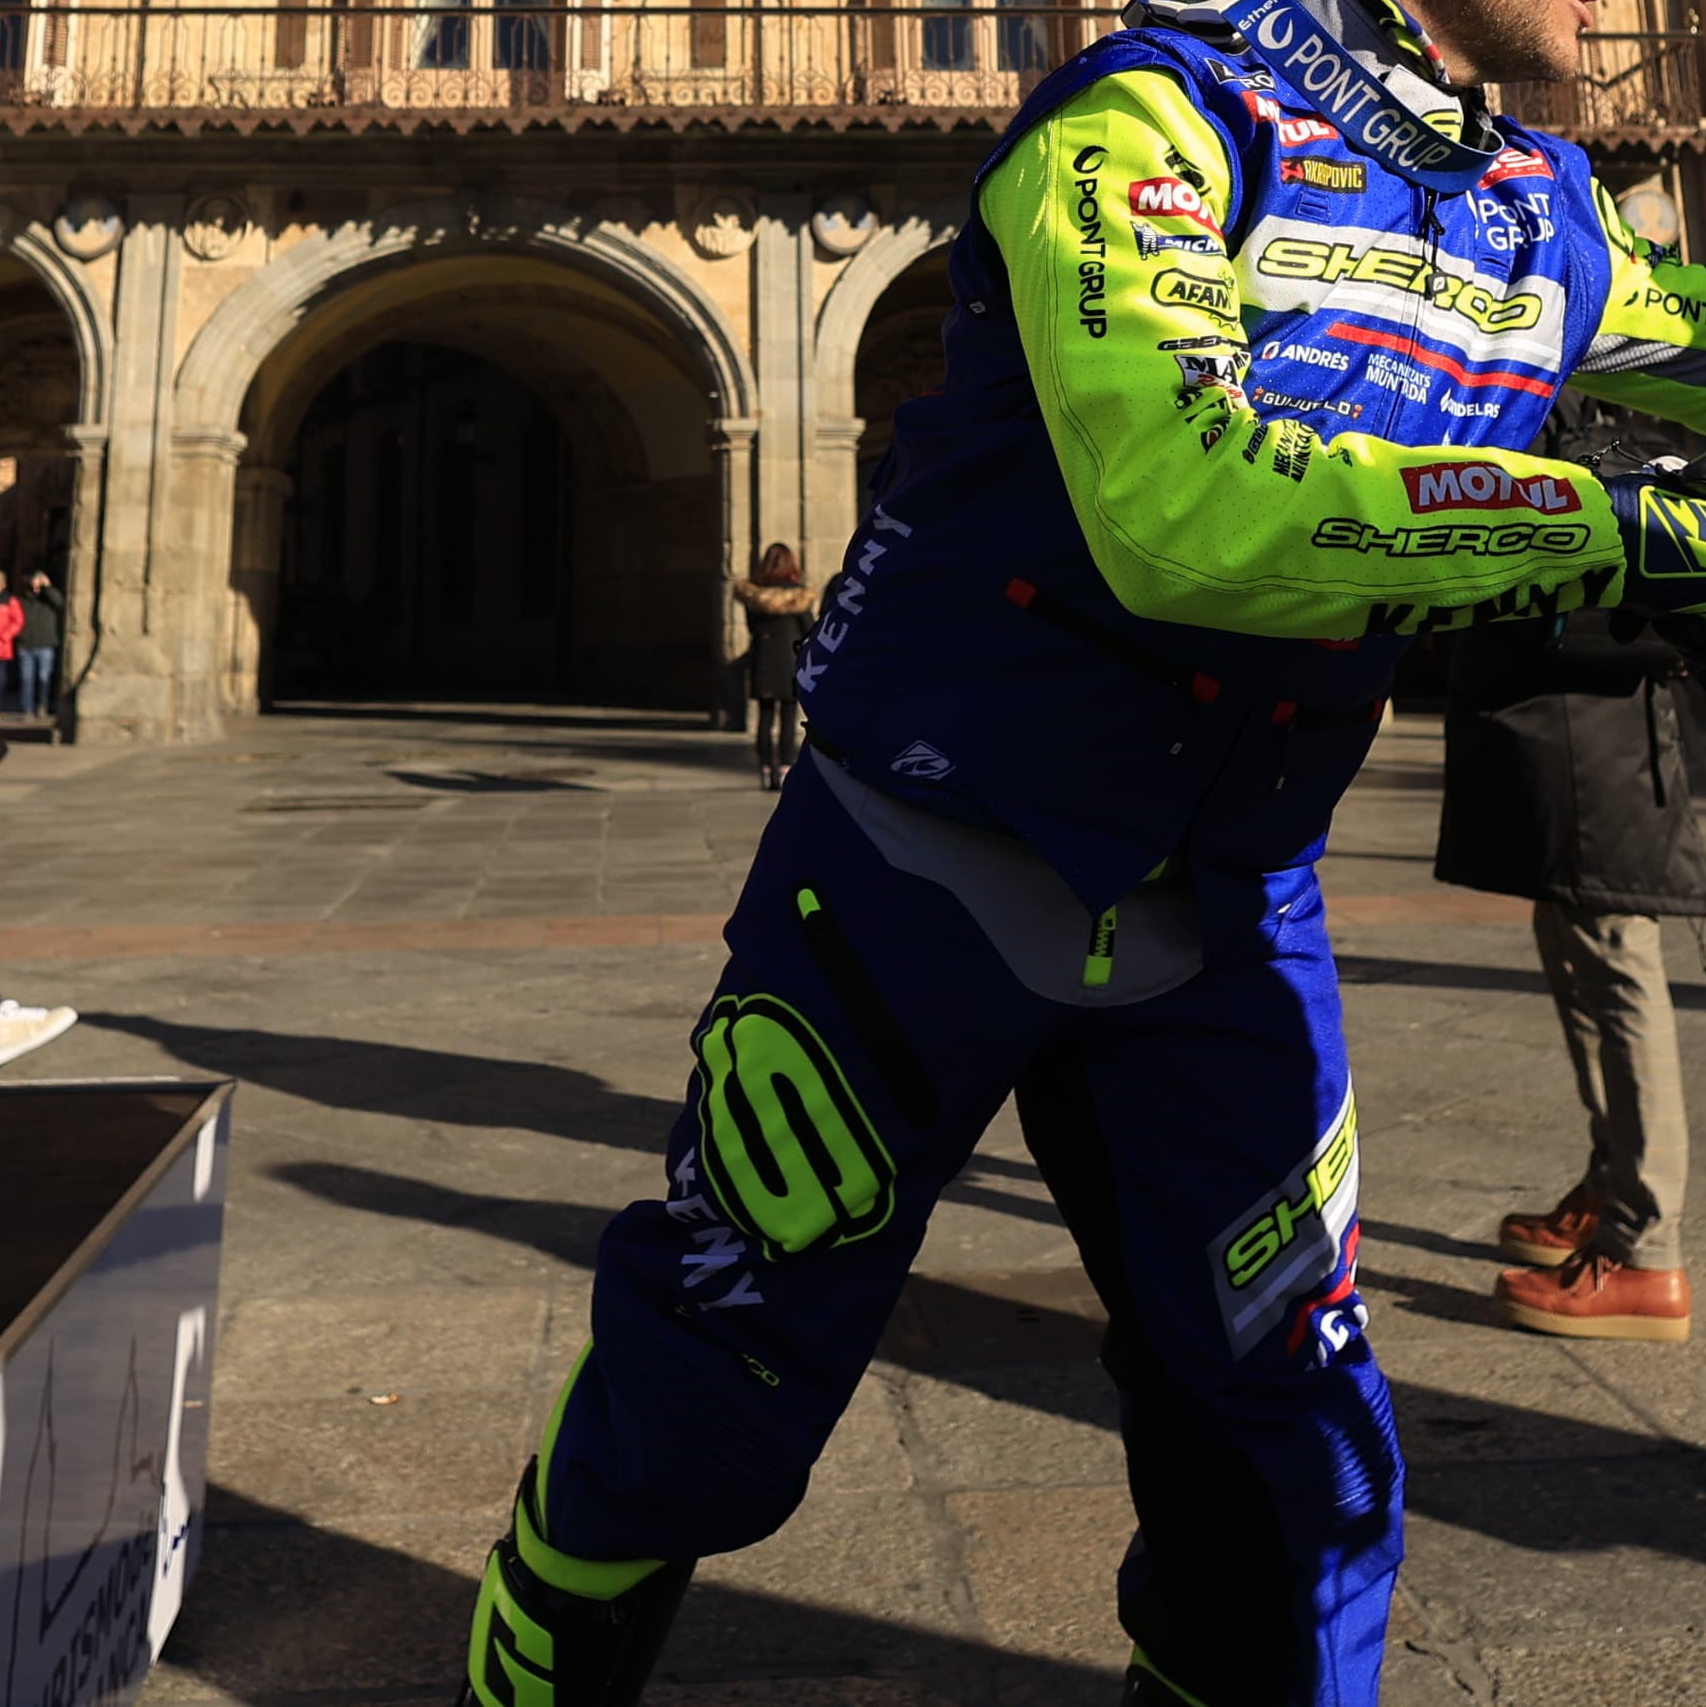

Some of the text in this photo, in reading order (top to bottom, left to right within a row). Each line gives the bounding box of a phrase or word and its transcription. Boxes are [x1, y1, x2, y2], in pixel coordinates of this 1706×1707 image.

[1284, 33, 1382, 125] PONT
[1362, 107, 1452, 172] GRUP
[1477, 193, 1551, 226] PONT
[1075, 179, 1108, 340] PONT GRUP
[1418, 469, 1569, 513] MOTUL
[1312, 518, 1592, 558] SHERCO
[796, 503, 913, 693] KENNY
